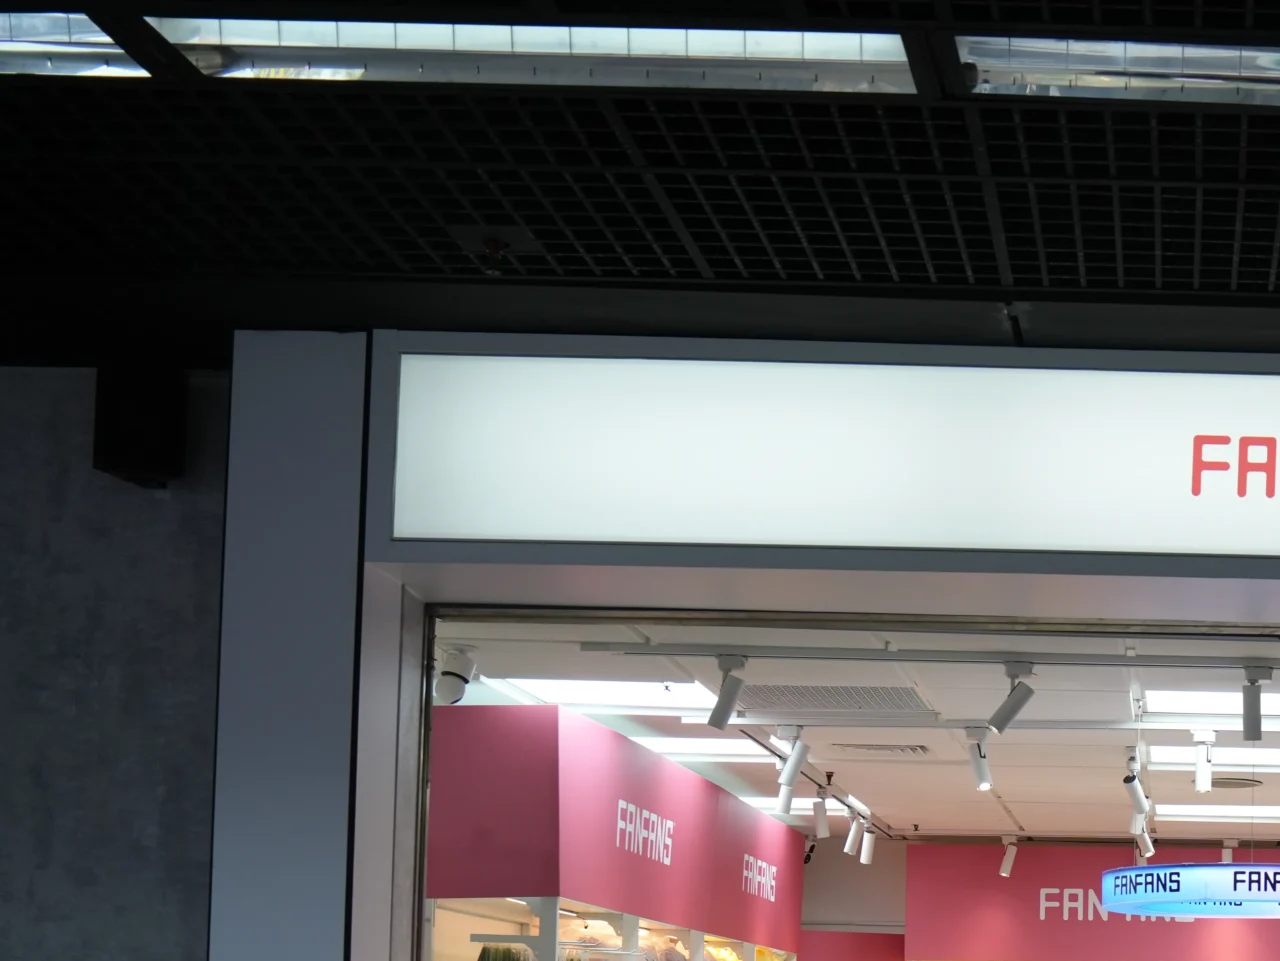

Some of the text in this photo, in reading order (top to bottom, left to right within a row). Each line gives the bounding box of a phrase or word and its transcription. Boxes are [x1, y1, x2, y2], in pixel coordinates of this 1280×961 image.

[616, 799, 674, 866] FANFANS
[742, 853, 777, 902] FANFANS
[1113, 872, 1181, 896] FANFANS
